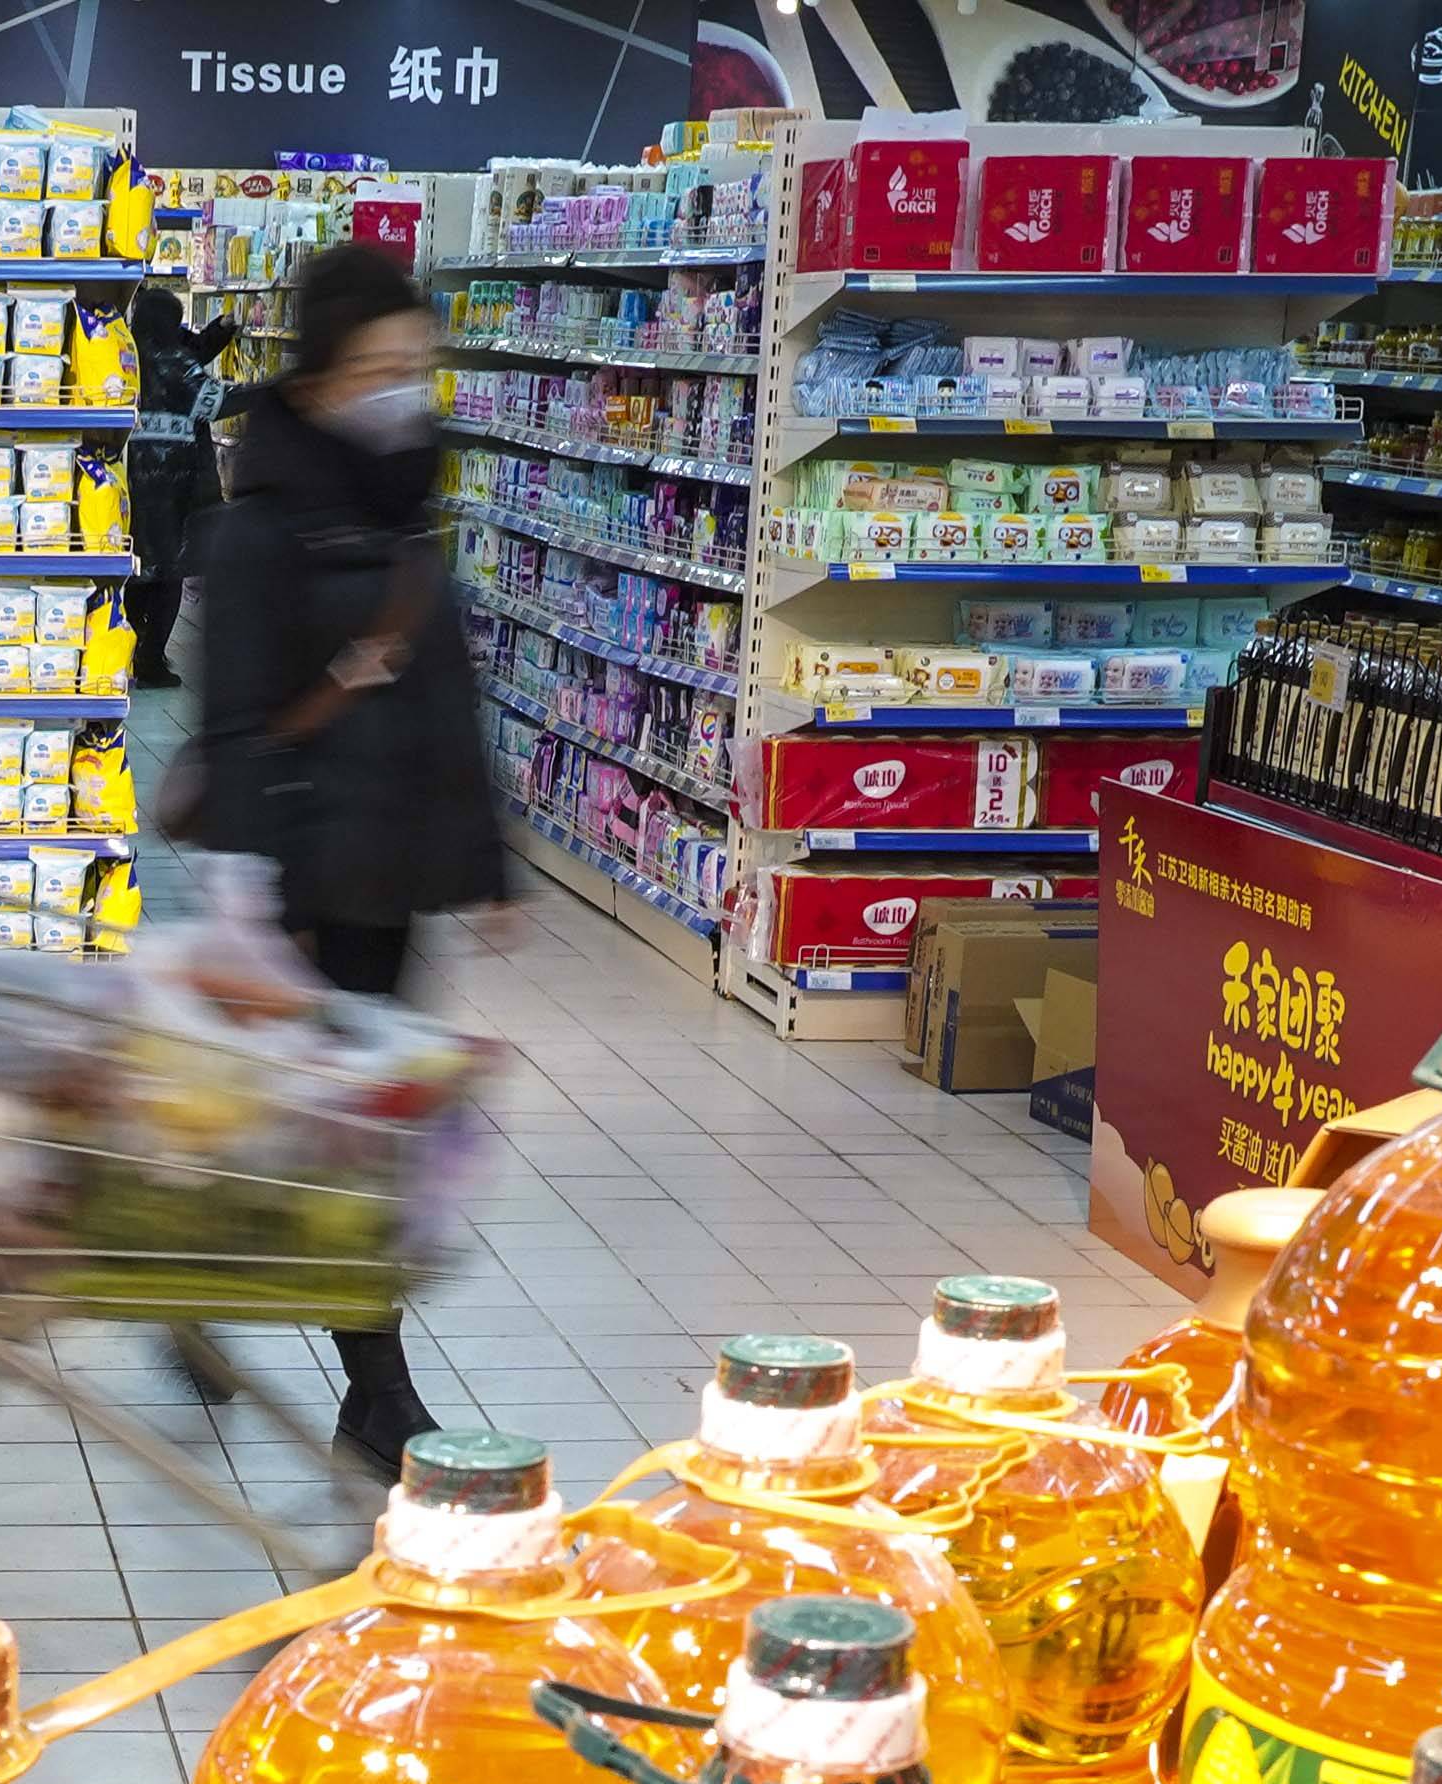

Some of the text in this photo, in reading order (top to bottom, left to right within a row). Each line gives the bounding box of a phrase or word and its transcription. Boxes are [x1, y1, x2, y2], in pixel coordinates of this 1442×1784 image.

[181, 50, 346, 94] Tissue
[388, 45, 499, 104] 纸巾
[1339, 53, 1406, 155] KITCHEN
[1119, 816, 1153, 886] 千禾
[1156, 852, 1312, 931] 江苏卫视新相亲大会冠名赞助商
